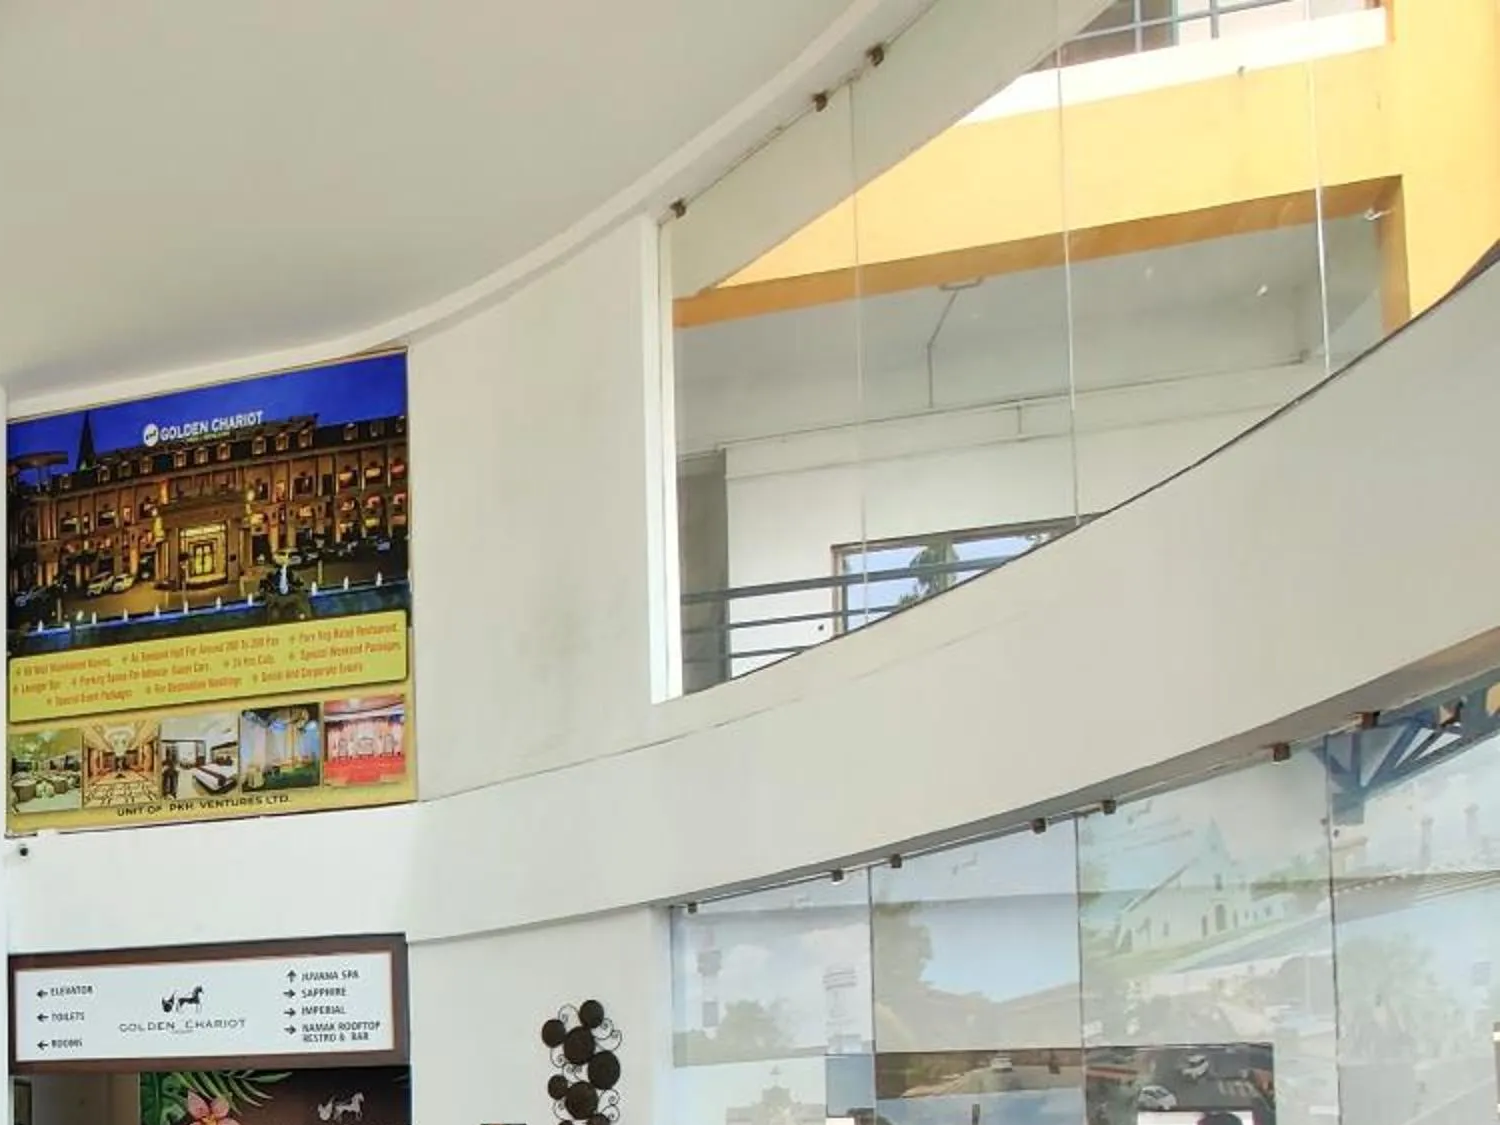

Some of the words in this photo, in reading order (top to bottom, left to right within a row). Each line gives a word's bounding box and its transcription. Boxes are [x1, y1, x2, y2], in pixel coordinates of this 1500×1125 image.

[160, 421, 209, 441] GOLDEN
[211, 411, 263, 432] CHARIOT
[117, 806, 143, 817] UNIT
[199, 797, 264, 810] VENTURES
[301, 970, 339, 982] JUVANA
[341, 969, 360, 980] SPA
[50, 985, 93, 998] ELEVATOR
[301, 987, 347, 999] SAPPHIRE
[301, 1004, 347, 1016] IMPERIAL
[51, 1011, 85, 1023] TOILETS
[118, 1020, 175, 1034] GOLDEN
[184, 1018, 247, 1030] CHARIOT
[338, 1020, 380, 1032] ROOFTOP
[51, 1036, 83, 1049] ROOMS
[302, 1032, 337, 1043] RESTRO
[350, 1030, 370, 1041] BAR
